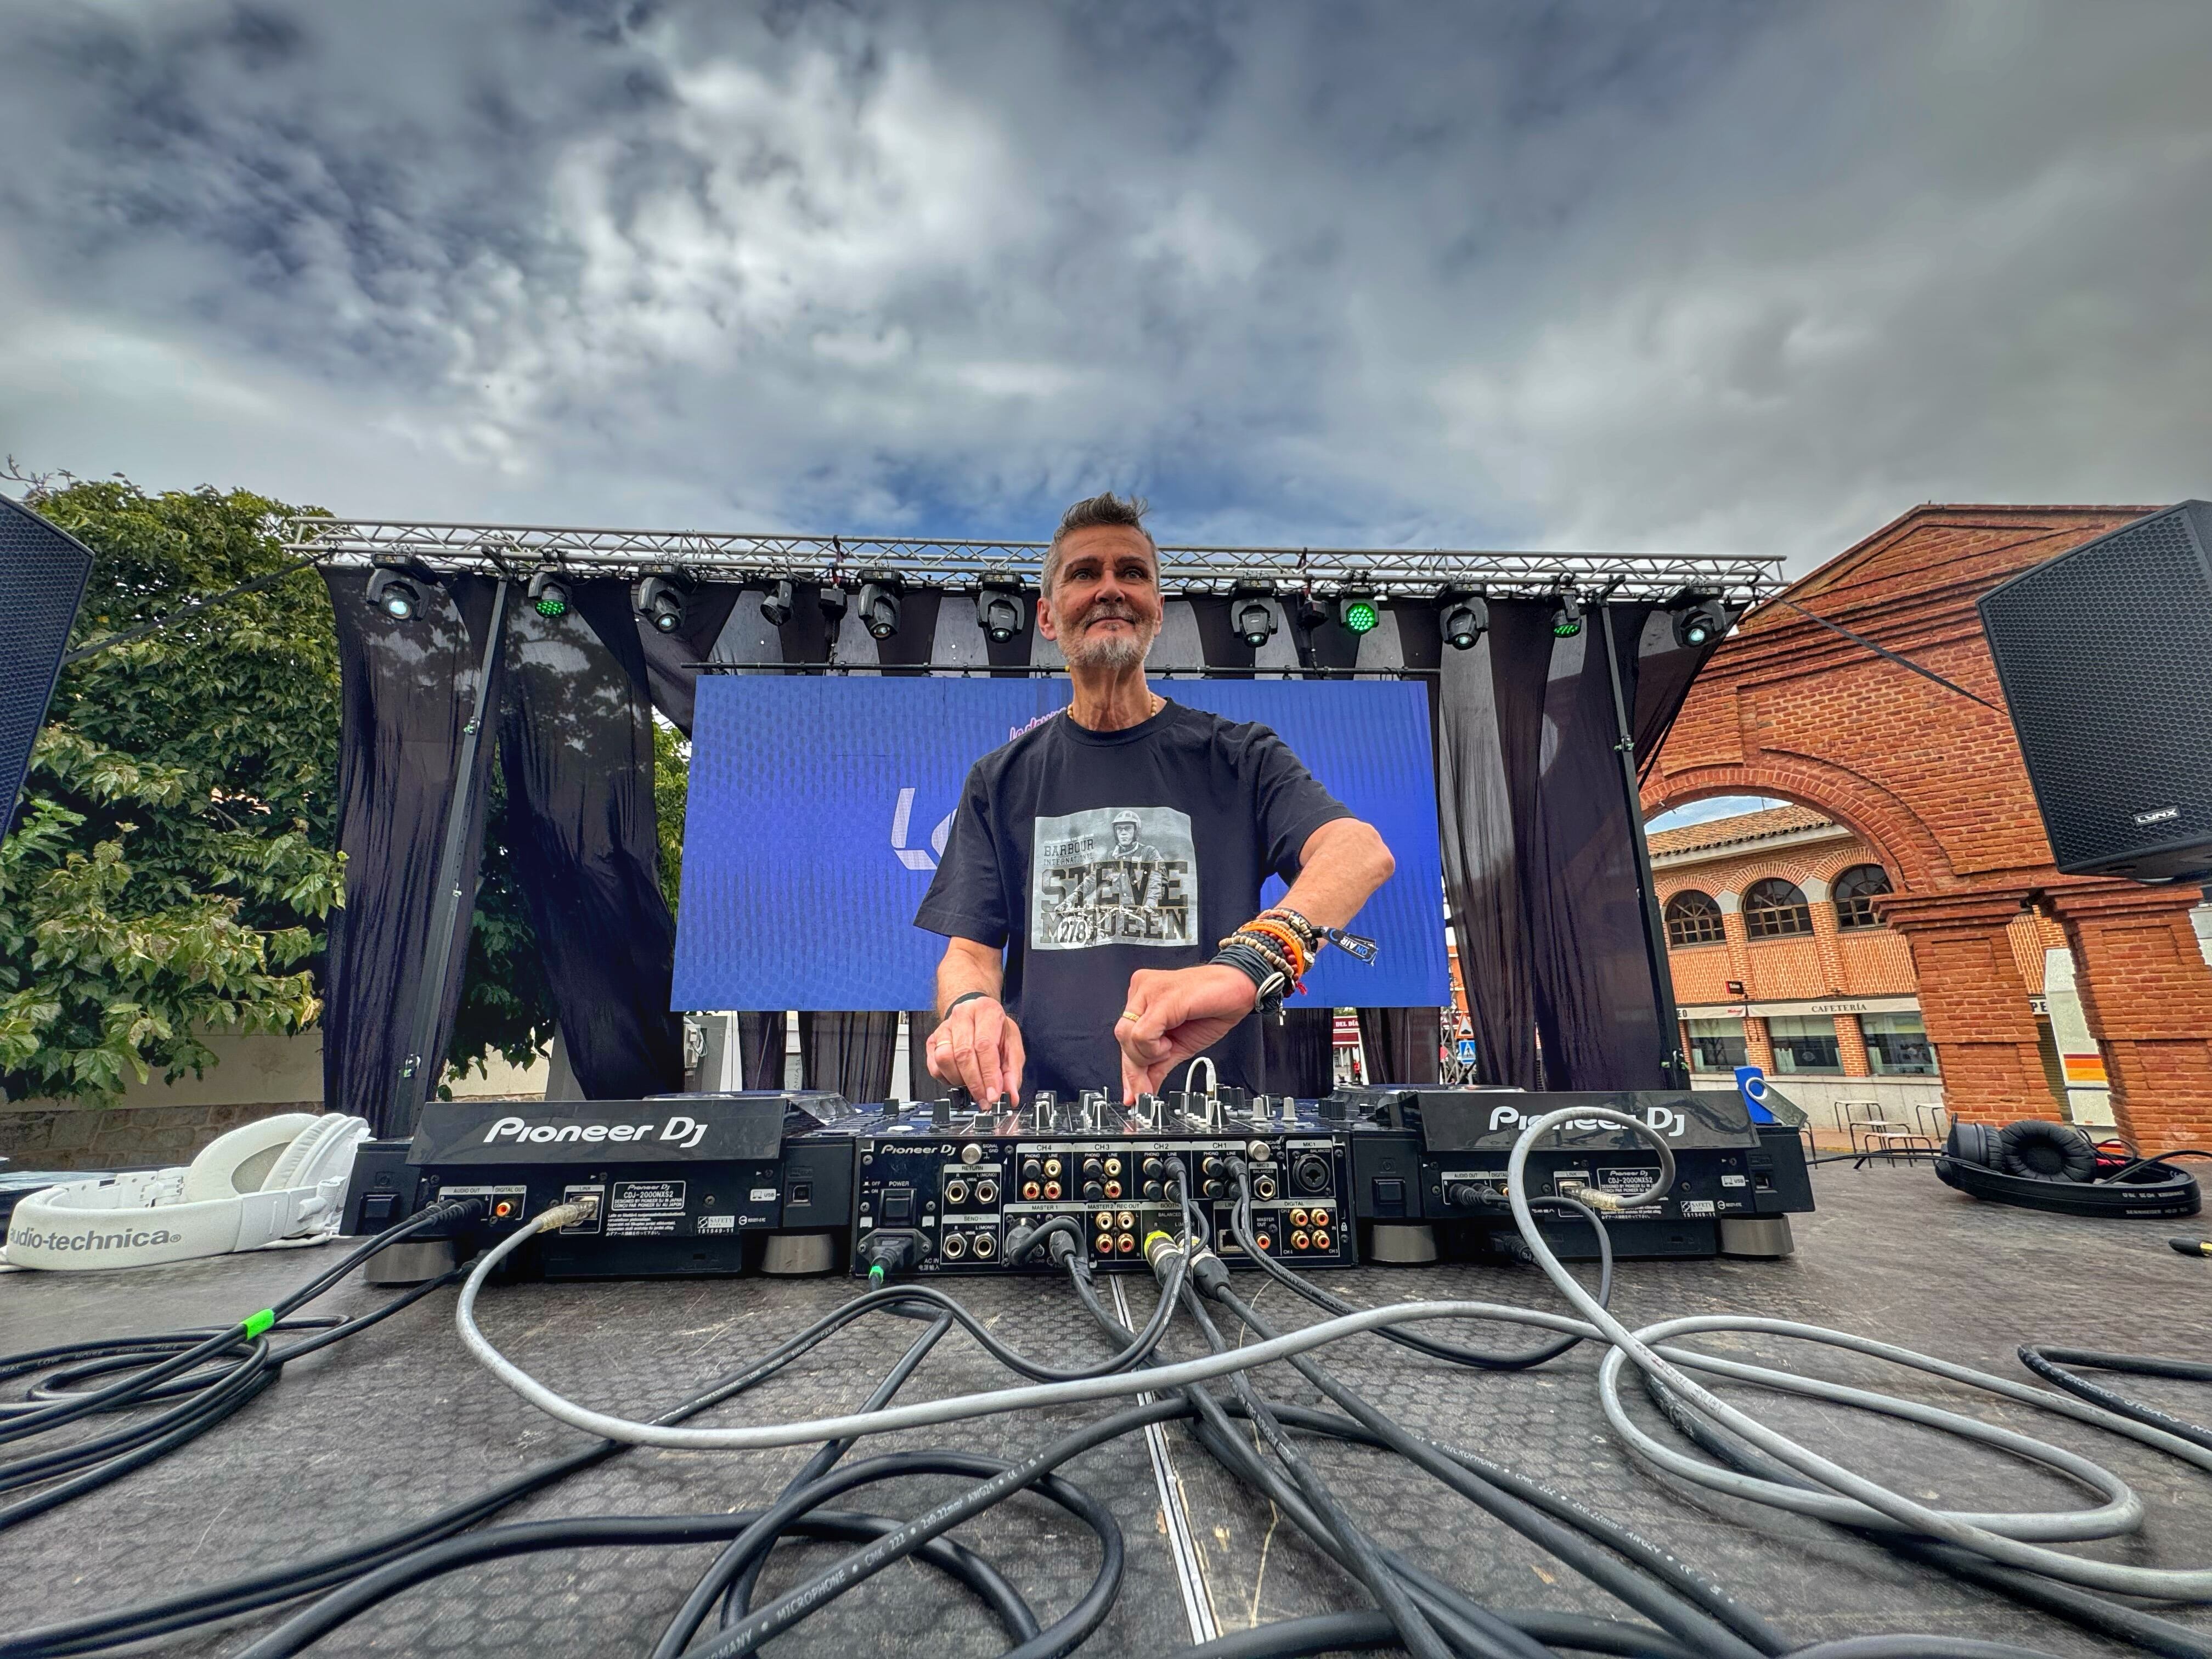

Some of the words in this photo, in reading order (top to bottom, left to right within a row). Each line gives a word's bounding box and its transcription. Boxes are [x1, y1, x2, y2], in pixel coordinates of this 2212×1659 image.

[2137, 808, 2177, 822] LYNX
[1043, 839, 1094, 856] BARBOUR
[1043, 852, 1094, 866] INTERNATIONAL
[1042, 861, 1188, 912] STEVE
[1059, 921, 1086, 943] 278
[1340, 937, 1357, 949] AIR
[1355, 945, 1368, 956] ON
[1812, 1002, 1867, 1013] CAFETERÍA
[483, 1117, 653, 1143] Pioneer
[881, 1144, 938, 1154] Pioneer
[696, 1380, 741, 1403] PROFESSIONAL
[791, 1341, 812, 1357] SIGNAL
[1443, 1444, 1500, 1470] MICROPHONE
[1515, 1474, 1533, 1486] CMK
[777, 1569, 846, 1623] MICROPHONE
[865, 1547, 884, 1566] CMK
[889, 1532, 905, 1550] 222
